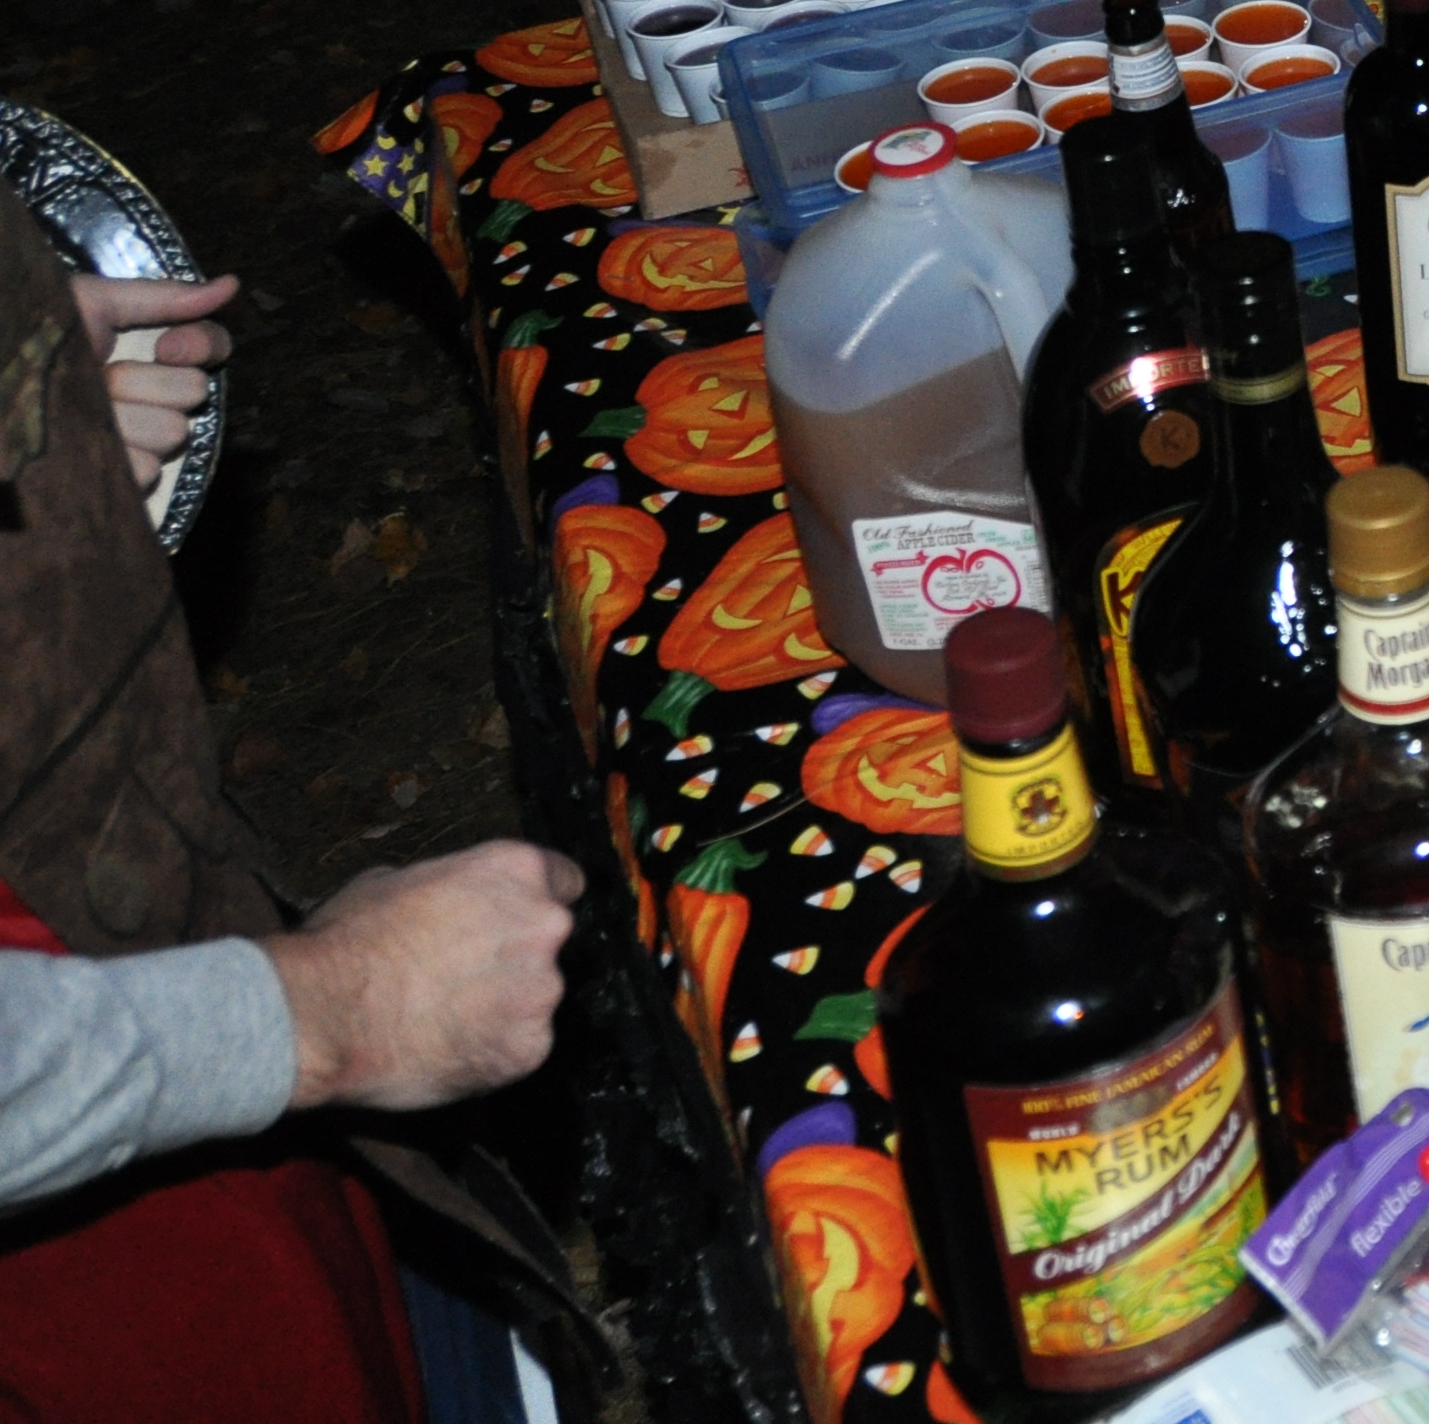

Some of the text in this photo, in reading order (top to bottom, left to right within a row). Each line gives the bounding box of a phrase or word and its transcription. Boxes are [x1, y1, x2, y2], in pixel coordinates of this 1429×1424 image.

[896, 534, 935, 552] APPLE
[936, 531, 977, 548] CIDER
[1036, 1076, 1224, 1177] MYERS'S
[1095, 1132, 1194, 1197] RUM
[1033, 1109, 1242, 1281] Original Dark
[1350, 1178, 1423, 1259] flexible
